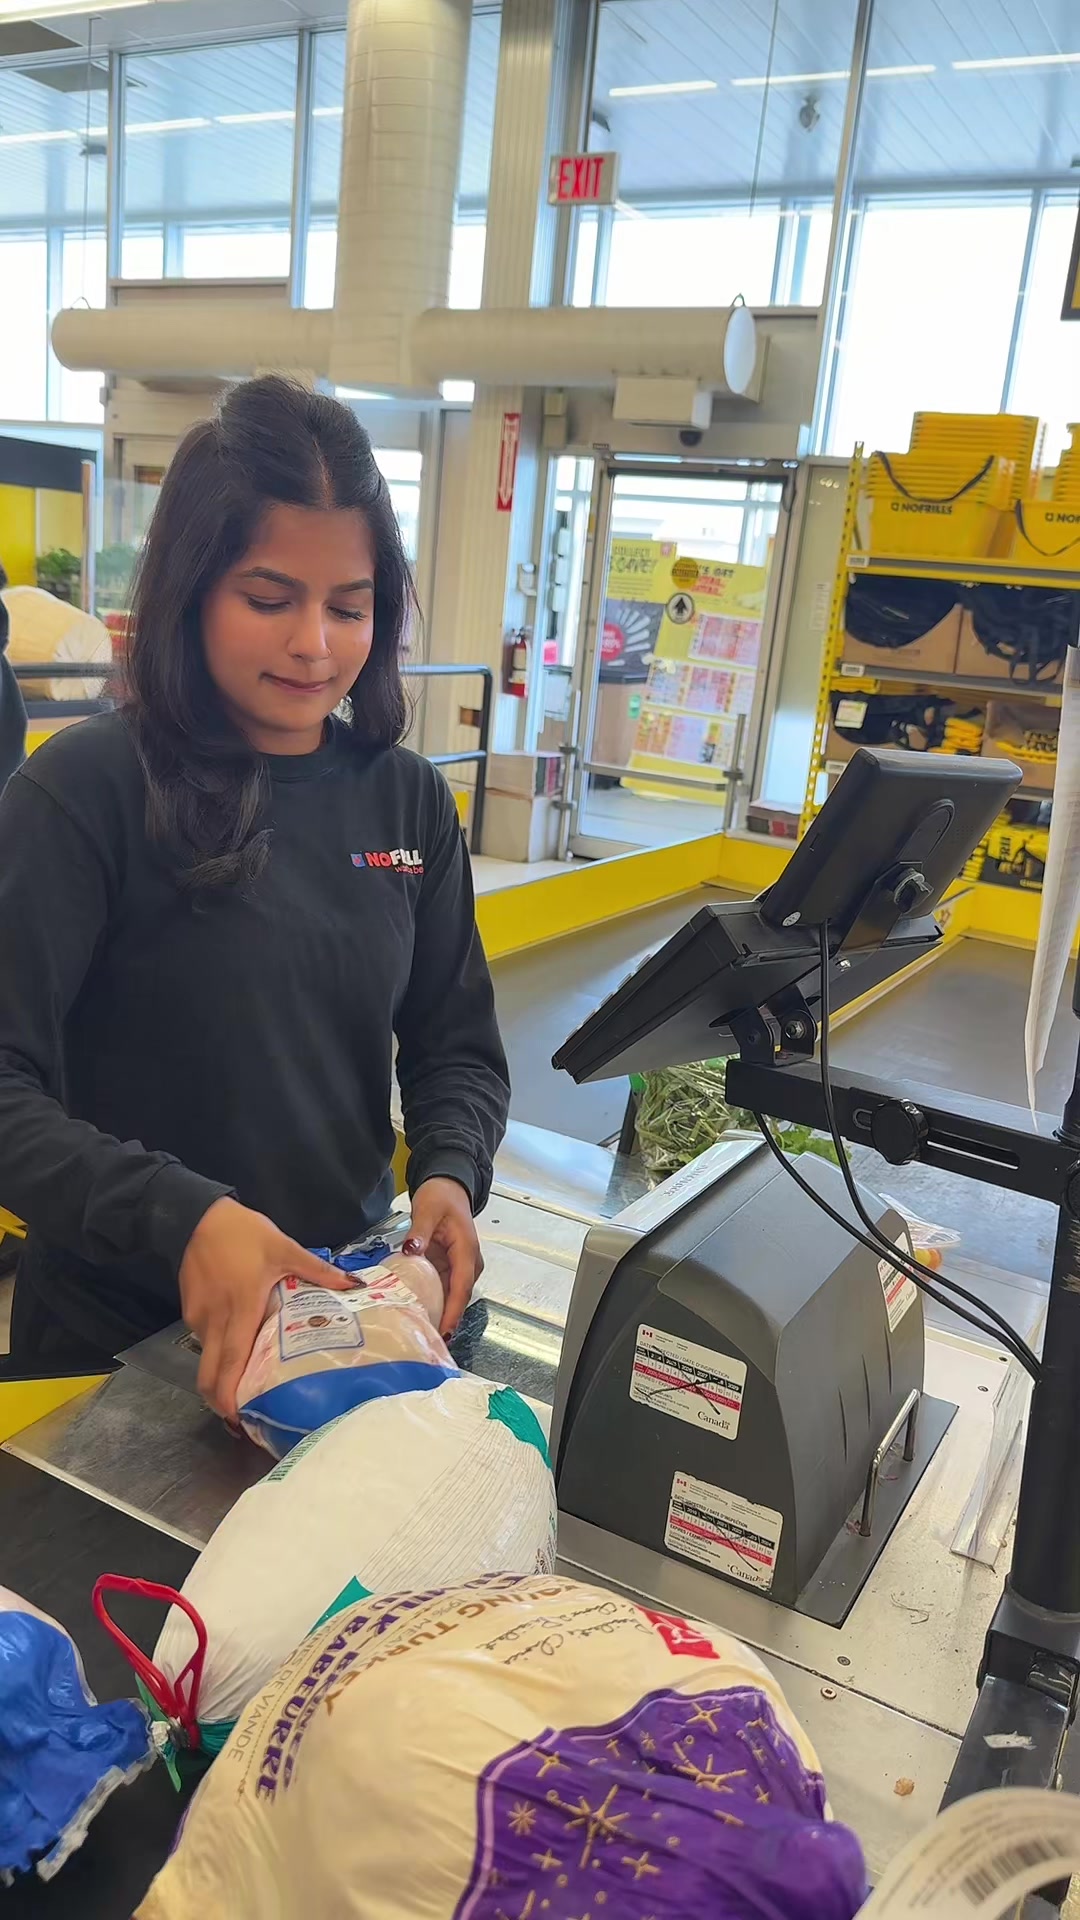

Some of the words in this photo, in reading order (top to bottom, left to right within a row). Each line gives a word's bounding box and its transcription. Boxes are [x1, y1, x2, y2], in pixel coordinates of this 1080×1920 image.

[557, 157, 604, 199] EXIT
[901, 503, 953, 515] NOFRILLS
[697, 1410, 730, 1430] Canada
[729, 1563, 765, 1584] Canad
[271, 1668, 294, 1691] DE
[323, 1619, 460, 1716] TURKEY
[255, 1614, 371, 1806] BABEURRE
[226, 1692, 276, 1763] VIANDE
